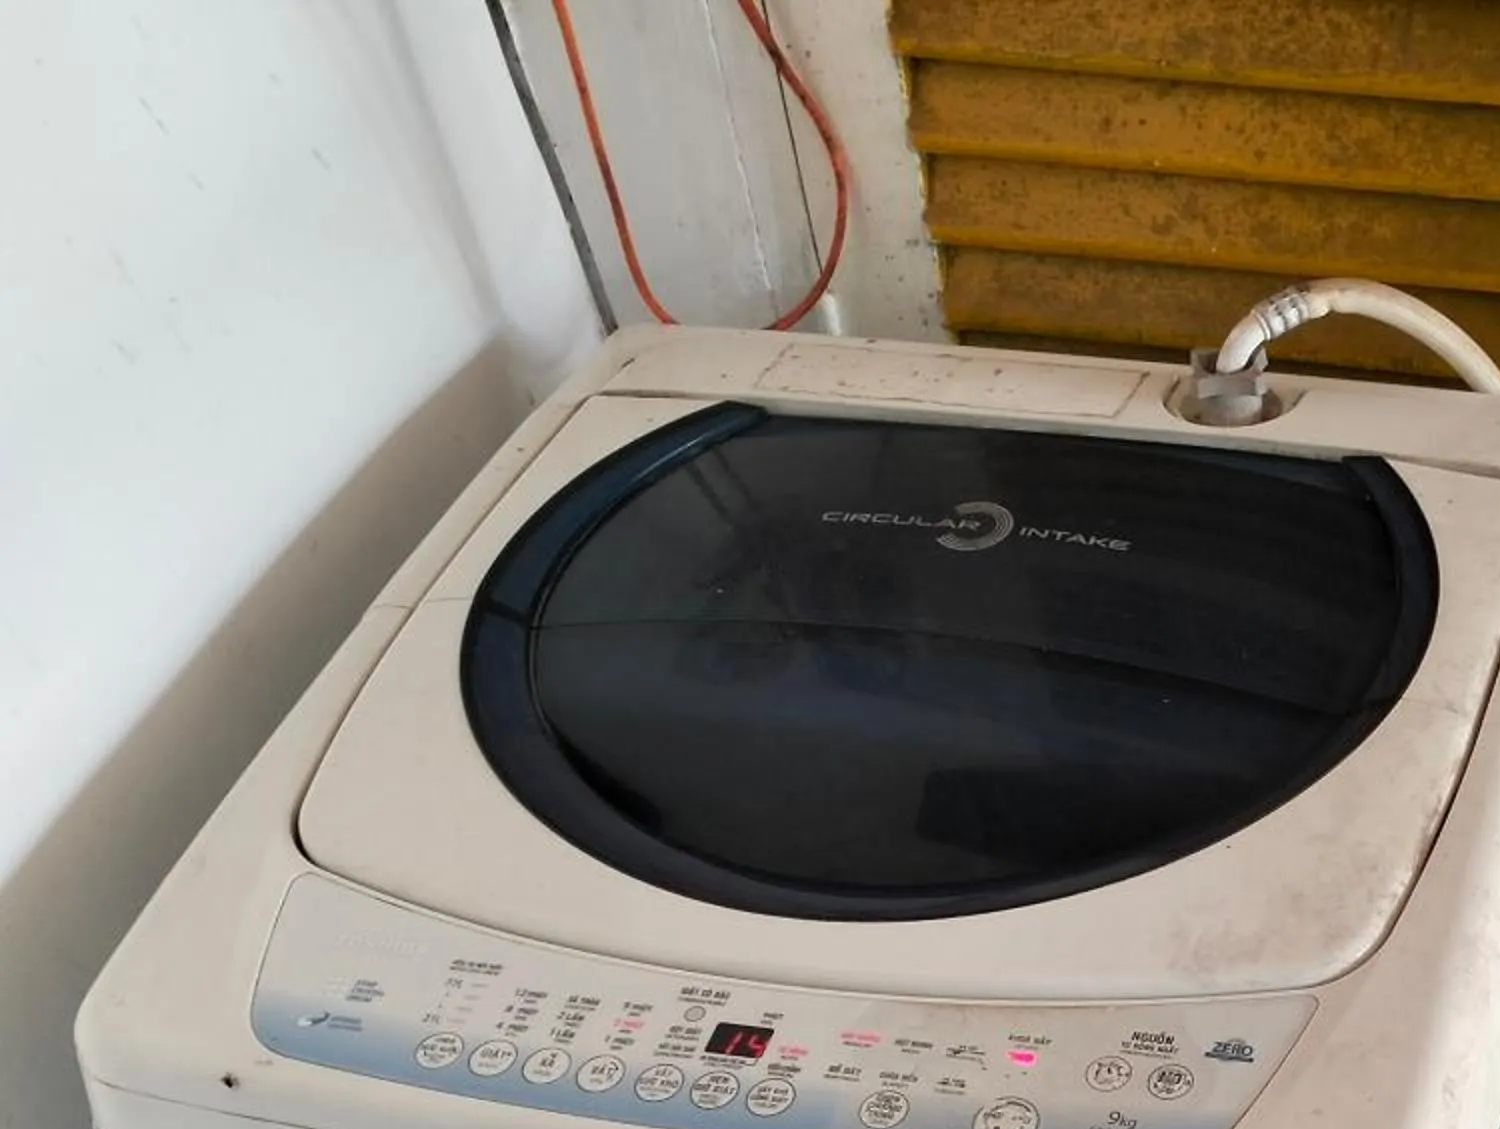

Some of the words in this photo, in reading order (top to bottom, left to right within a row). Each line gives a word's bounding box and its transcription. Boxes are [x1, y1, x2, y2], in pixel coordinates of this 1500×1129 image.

[821, 511, 981, 531] CIRCULAR
[1019, 526, 1133, 551] INTAKE
[1108, 1111, 1137, 1129] 9kg
